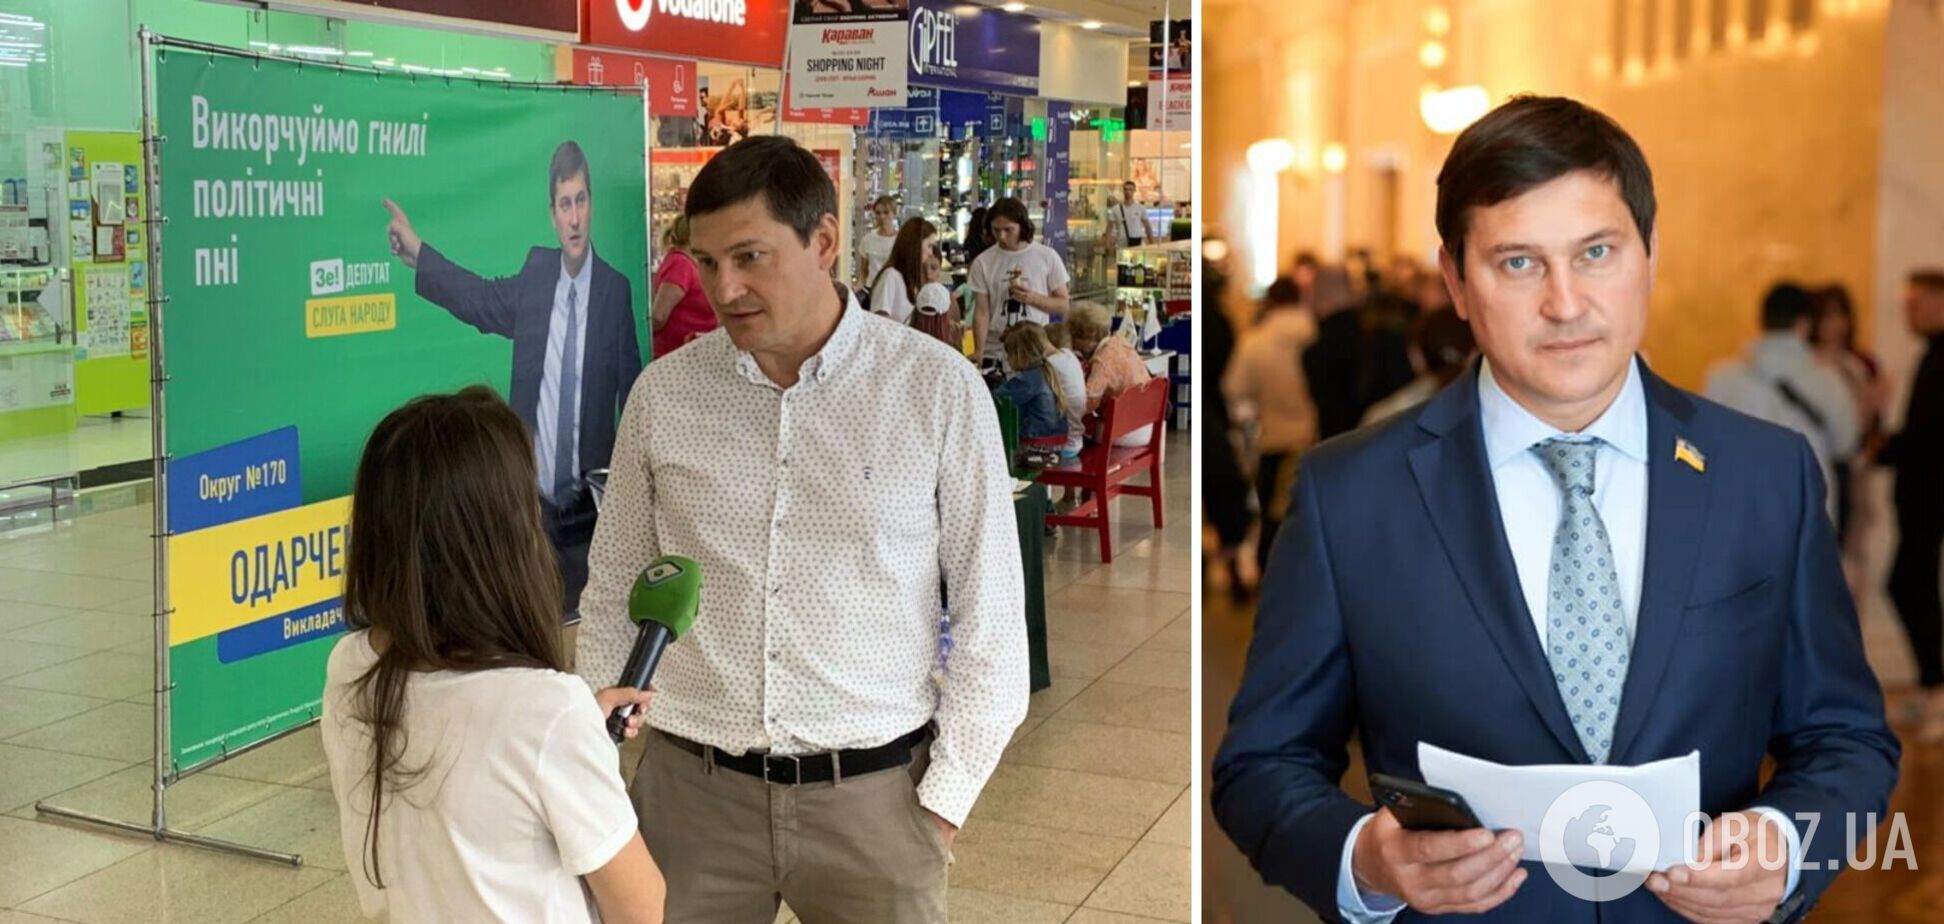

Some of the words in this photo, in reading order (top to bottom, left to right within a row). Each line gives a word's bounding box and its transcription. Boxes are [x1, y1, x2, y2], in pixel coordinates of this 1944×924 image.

[822, 28, 874, 44] Караван
[806, 58, 854, 73] SHOPPING
[856, 57, 886, 71] NIGHT
[191, 95, 359, 165] Викорчуймо
[368, 113, 429, 157] гнилі
[193, 168, 324, 218] політичні
[194, 234, 238, 286] пні
[315, 265, 340, 288] Зе!
[346, 262, 390, 288] ДЕПУТАТ
[312, 304, 347, 328] СЛУГА
[351, 301, 392, 325] НАРОДУ
[200, 474, 242, 503] Округ
[246, 459, 286, 491] №170
[283, 607, 344, 640] Викладач
